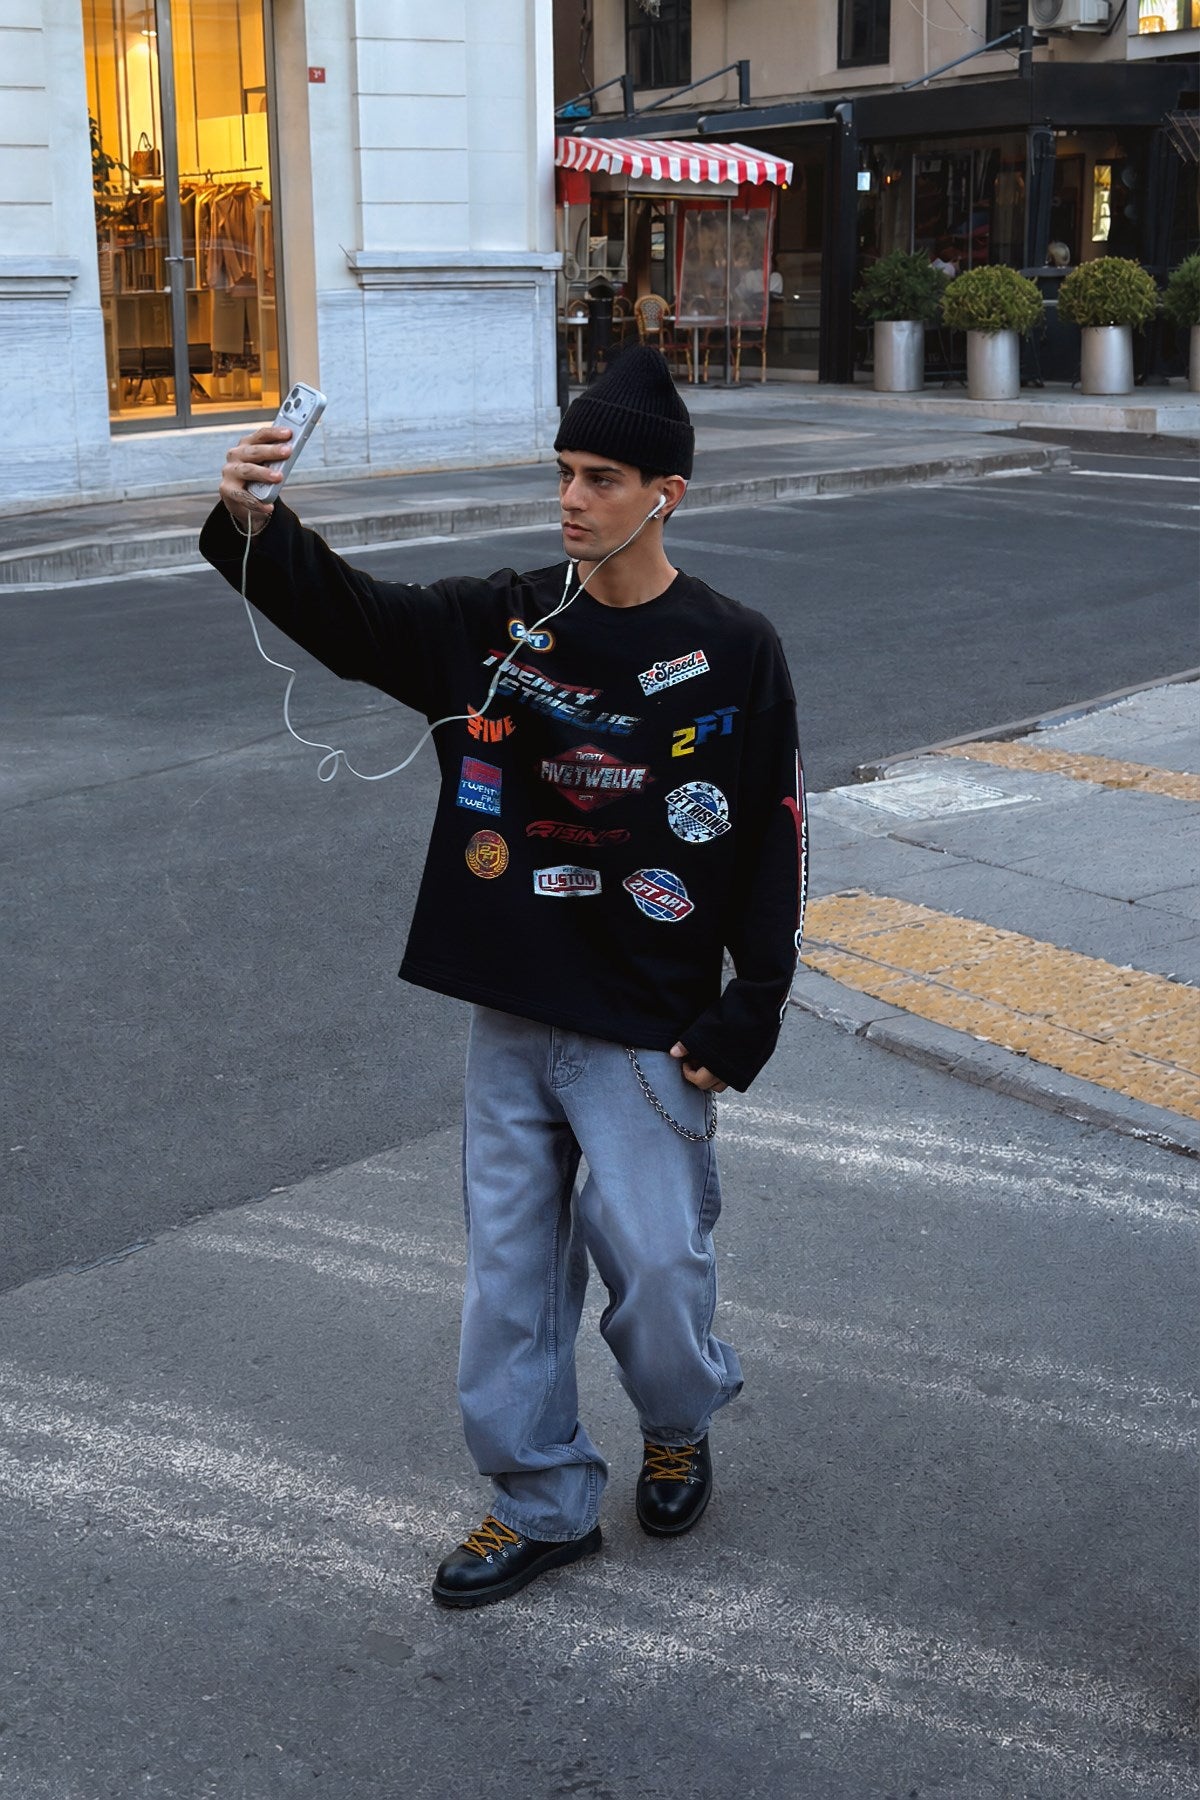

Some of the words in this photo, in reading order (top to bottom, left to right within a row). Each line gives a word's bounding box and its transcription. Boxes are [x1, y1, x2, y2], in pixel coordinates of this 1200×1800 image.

[654, 652, 697, 682] Speed
[671, 706, 740, 758] 2FT
[458, 796, 501, 814] TWELVE
[666, 789, 693, 811] 2FT
[687, 803, 729, 834] RISING
[538, 873, 597, 892] CUSTOM
[628, 879, 660, 897] 2FT
[655, 893, 688, 911] ART
